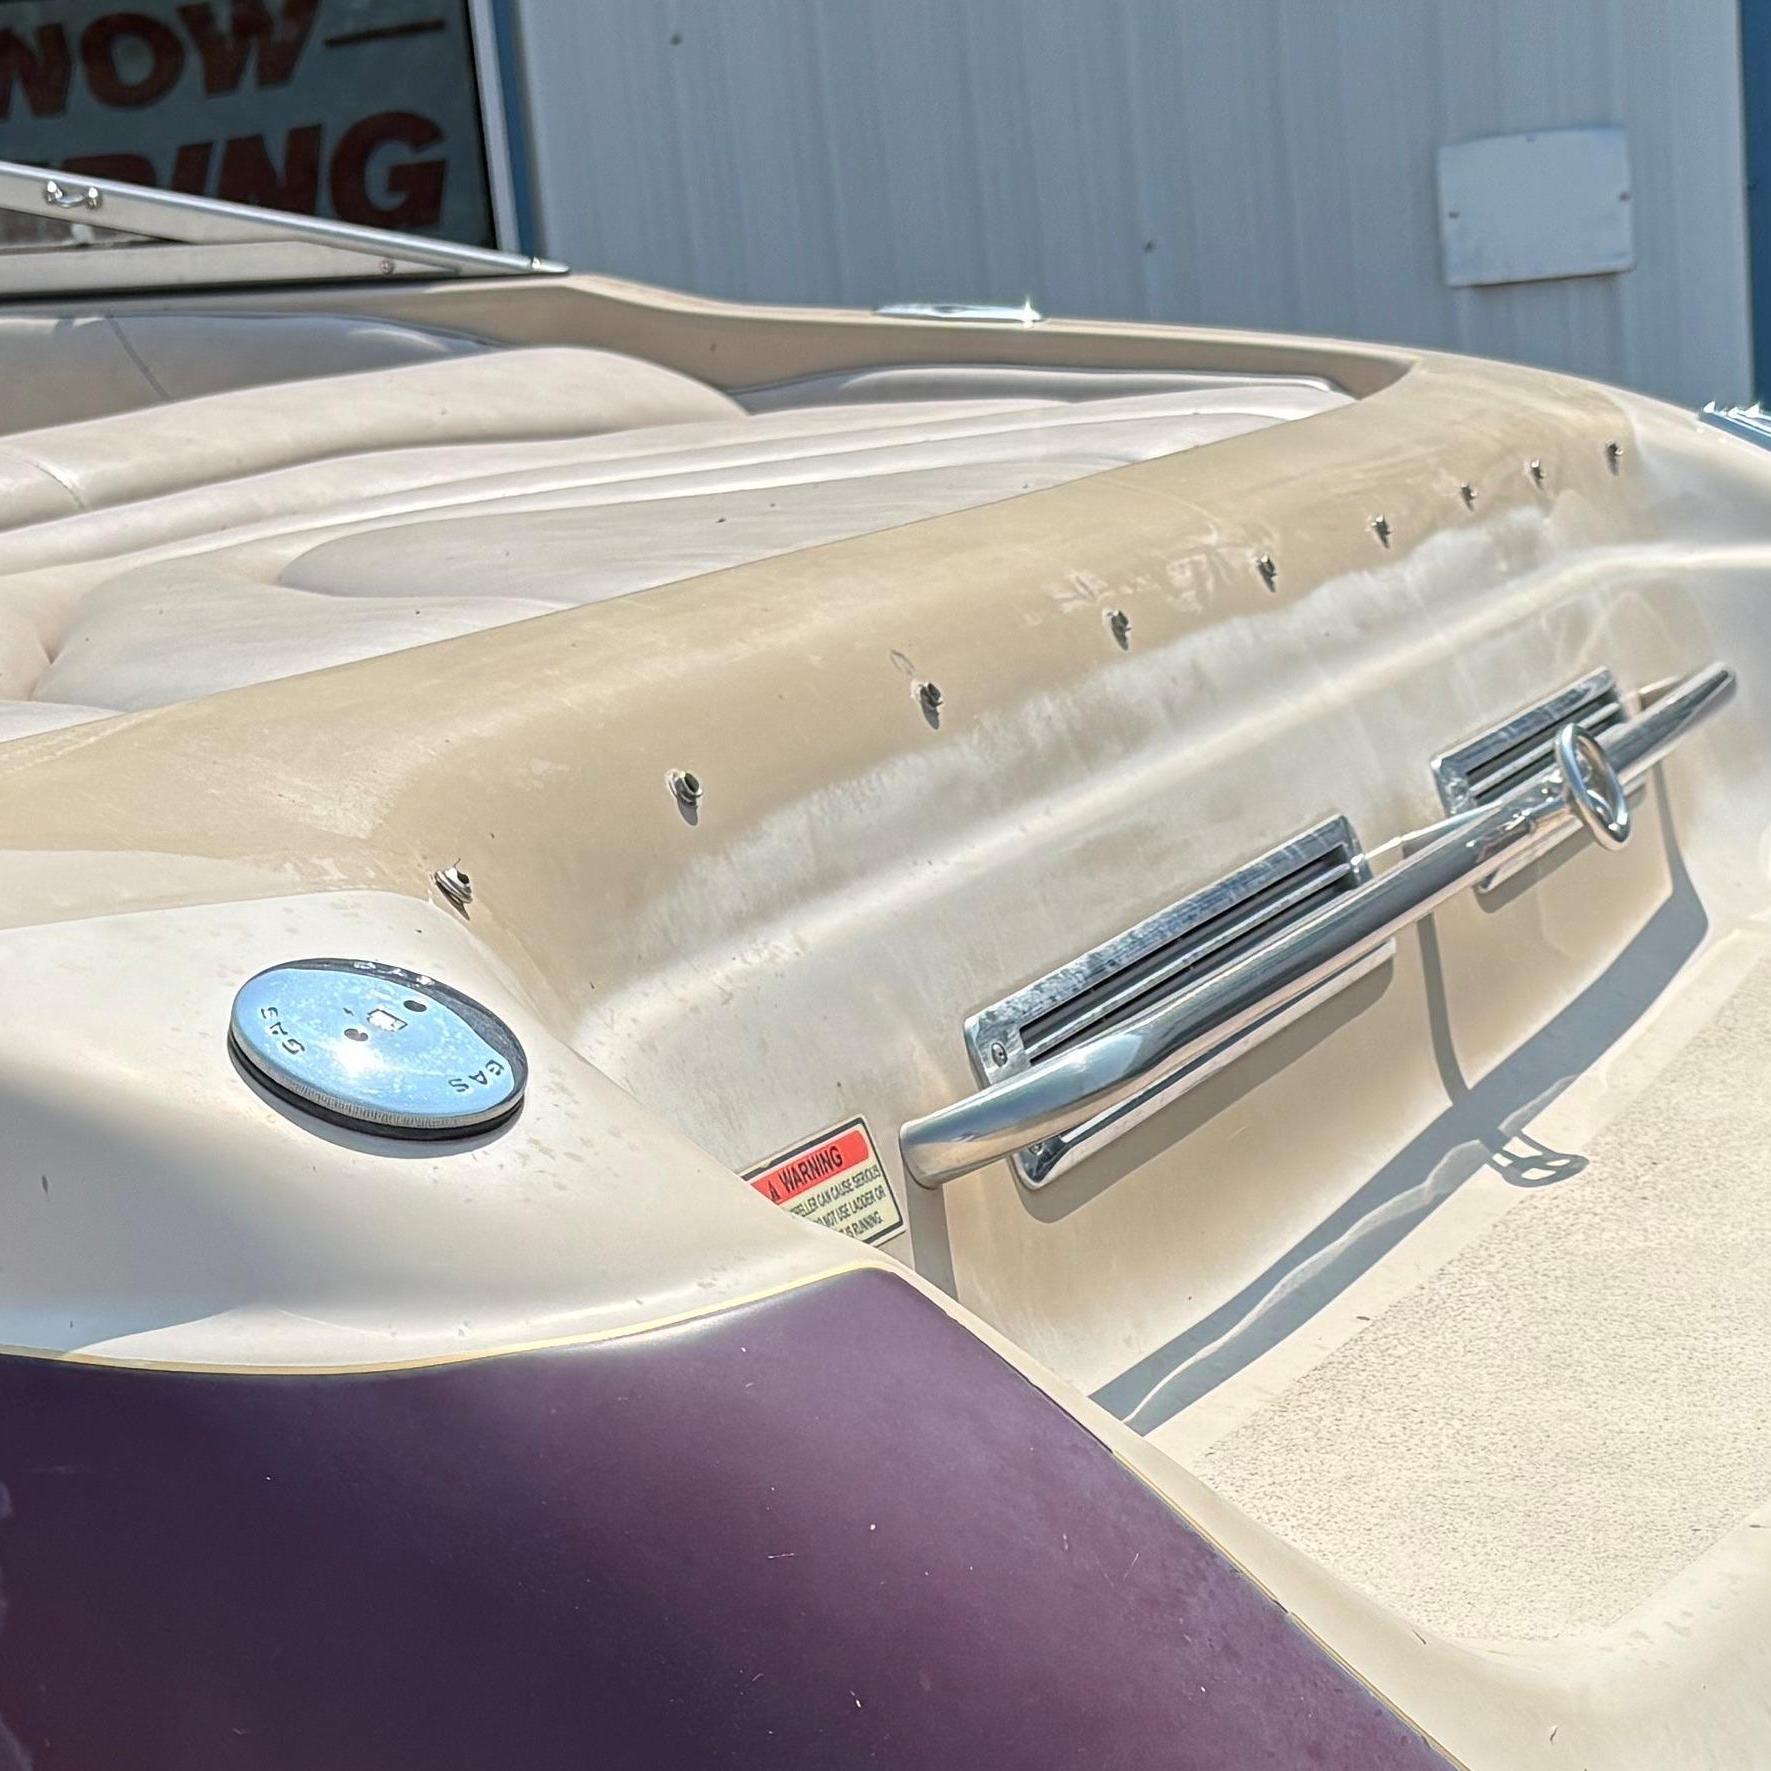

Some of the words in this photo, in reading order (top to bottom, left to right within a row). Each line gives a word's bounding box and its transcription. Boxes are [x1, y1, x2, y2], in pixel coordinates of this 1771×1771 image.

[260, 1006, 306, 1056] GAS
[447, 1058, 505, 1094] GAS
[778, 1146, 843, 1193] WARNING
[817, 1189, 832, 1207] CAN
[830, 1178, 854, 1200] CAUSE
[851, 1164, 881, 1188] SERIOUS
[835, 1202, 851, 1221] USE
[848, 1190, 876, 1214] LADDER
[874, 1184, 886, 1201] OR
